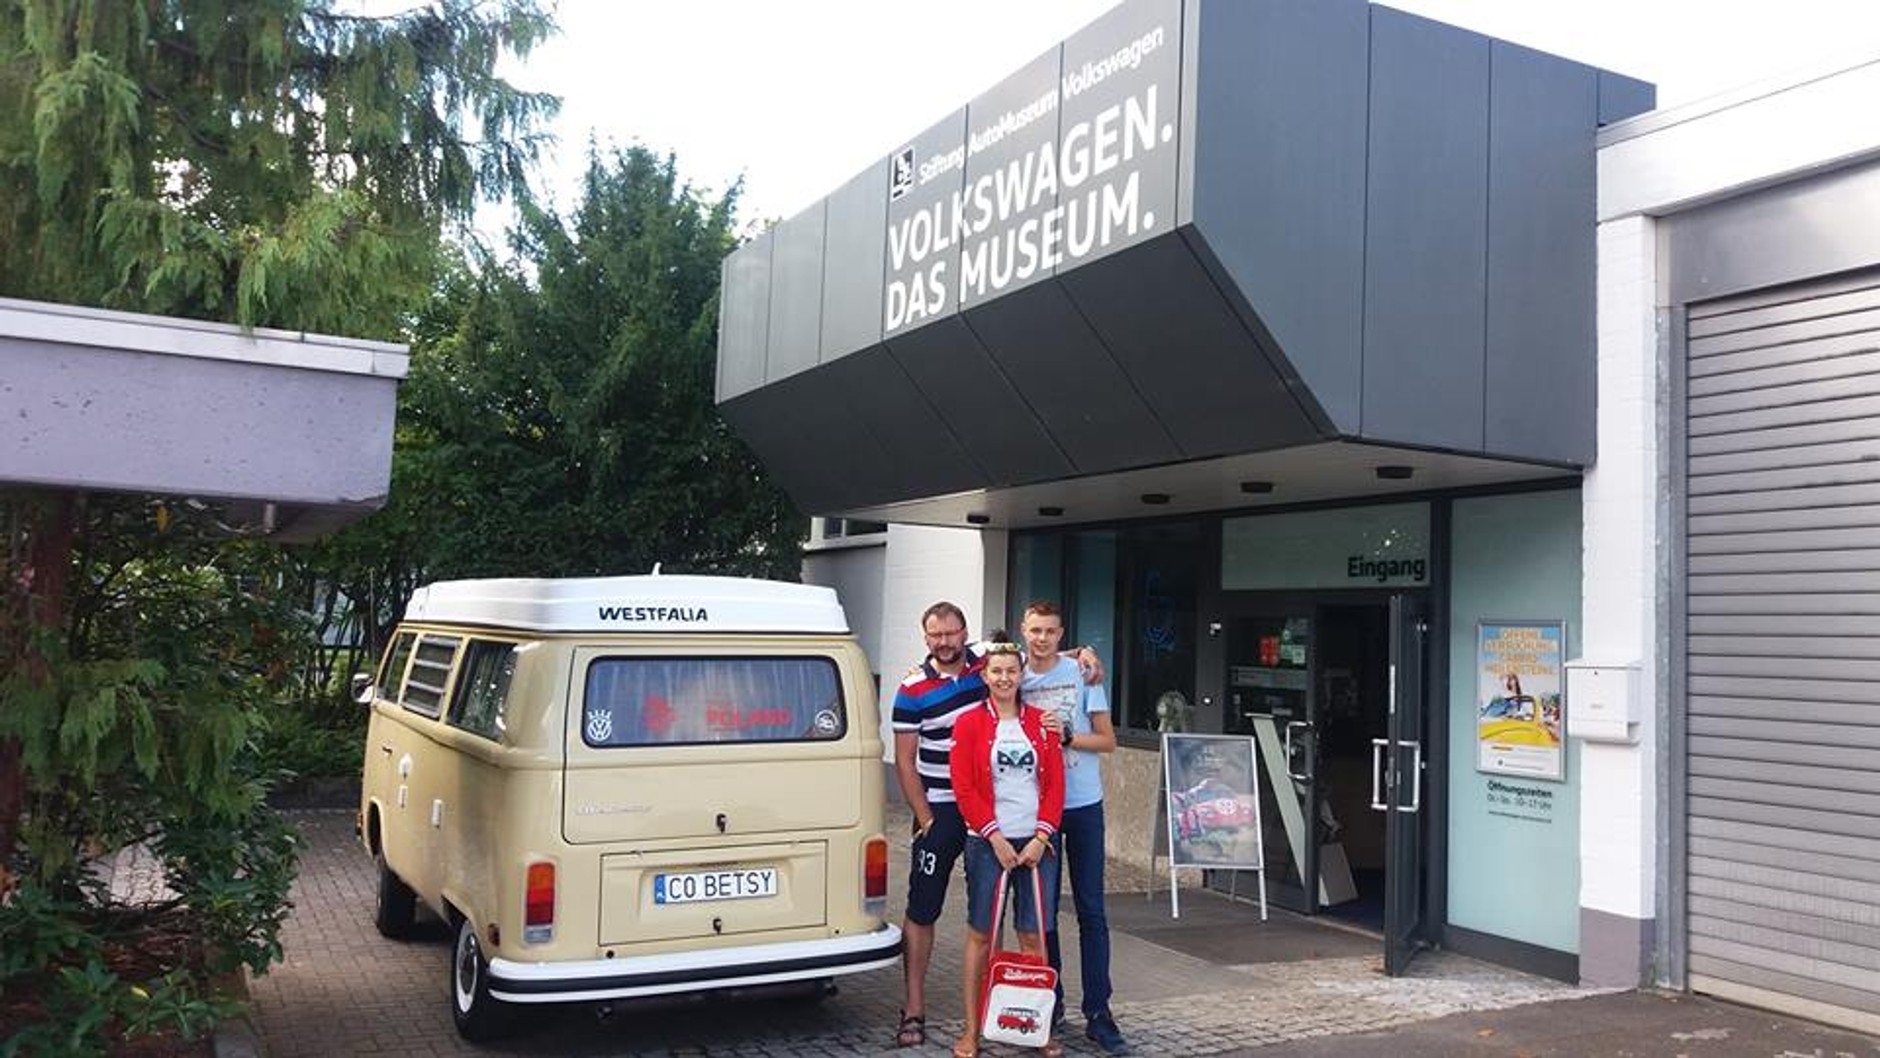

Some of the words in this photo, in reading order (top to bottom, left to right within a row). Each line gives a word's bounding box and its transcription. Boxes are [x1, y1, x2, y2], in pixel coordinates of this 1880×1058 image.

[919, 144, 965, 185] Stiftung
[968, 88, 1059, 155] AutoMuseum
[1062, 27, 1164, 99] Volkswagen
[889, 84, 1173, 271] VOLKSWAGEN.
[886, 260, 946, 331] DAS
[959, 171, 1155, 304] MUSEUM.
[599, 606, 709, 622] WESTFALIA
[1347, 555, 1426, 583] Eingang
[704, 871, 772, 898] BETSY
